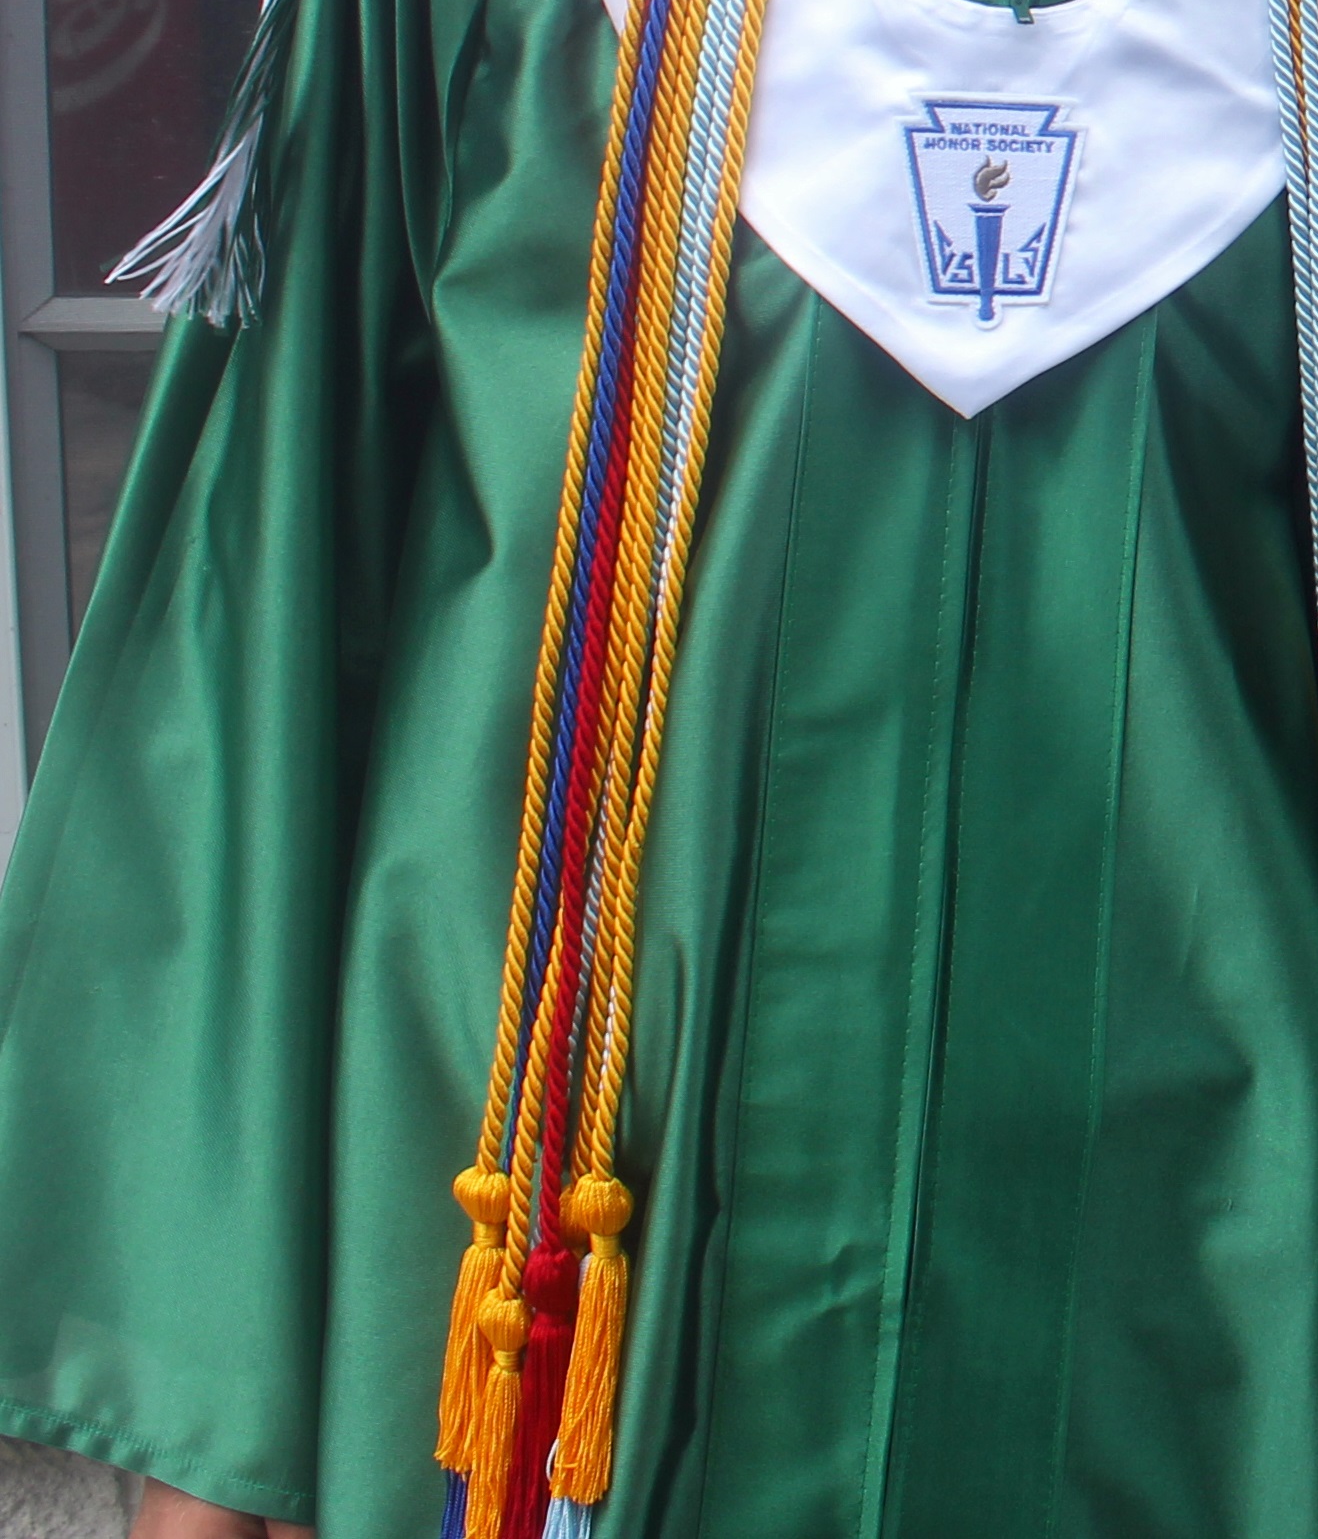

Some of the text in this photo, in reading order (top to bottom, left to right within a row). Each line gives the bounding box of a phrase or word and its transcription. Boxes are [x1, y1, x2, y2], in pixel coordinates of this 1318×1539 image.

[950, 122, 1030, 137] NATIONAL
[924, 137, 1056, 154] HONOR SOCIETY
